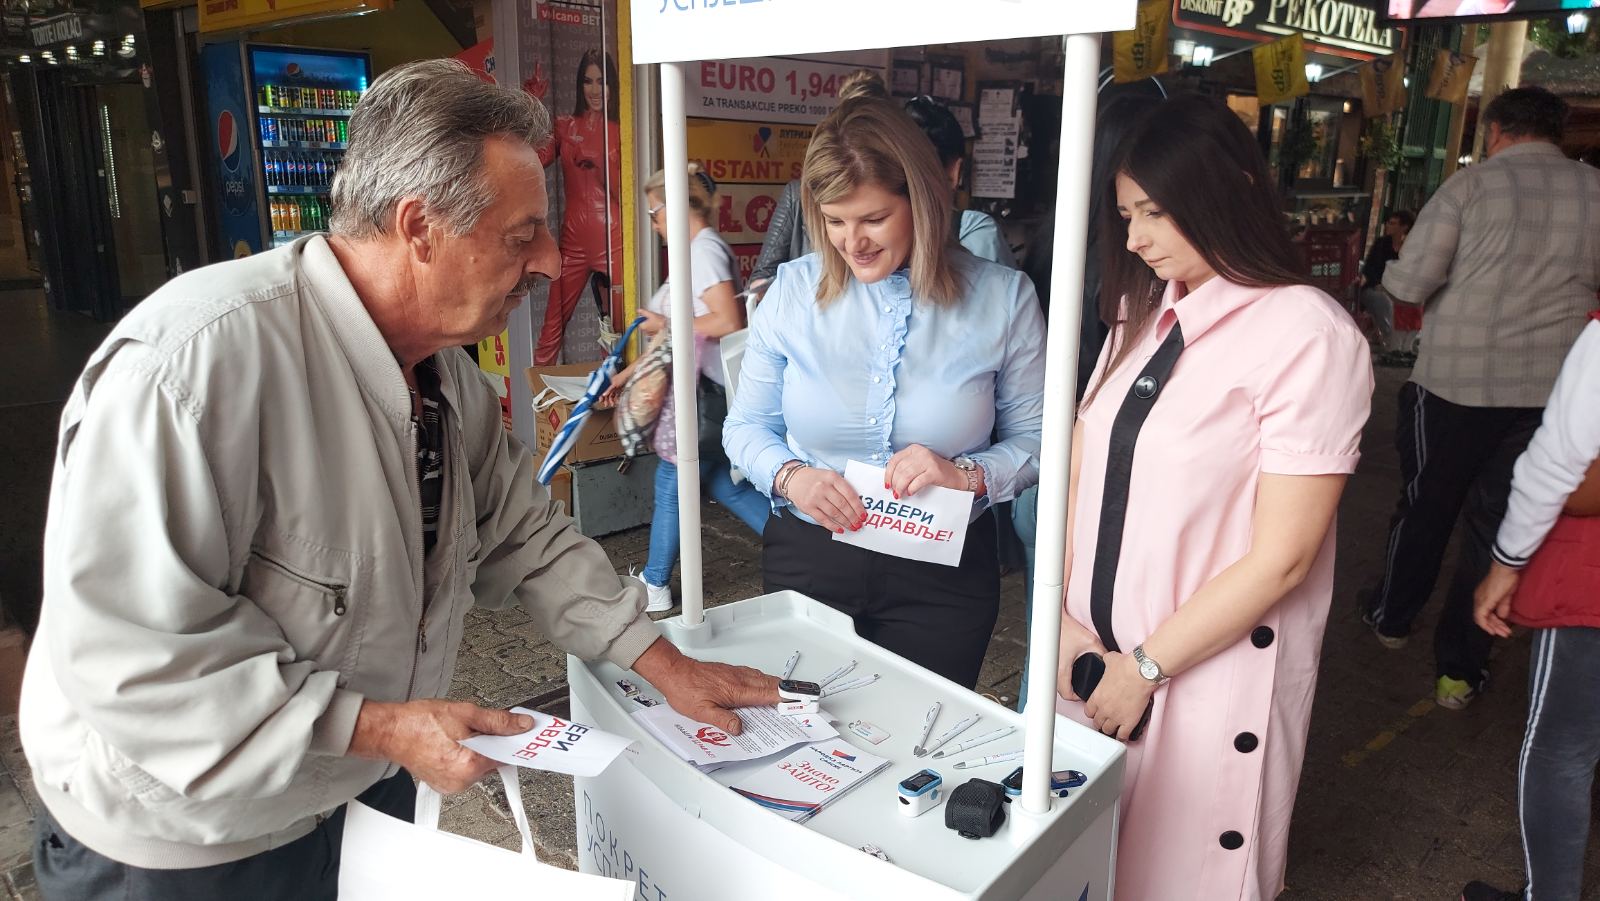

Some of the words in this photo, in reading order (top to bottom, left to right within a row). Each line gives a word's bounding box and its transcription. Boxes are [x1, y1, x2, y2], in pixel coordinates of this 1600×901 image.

[541, 9, 580, 23] vlcano
[582, 16, 600, 26] BET
[1266, 0, 1393, 47] PEKOTEKA
[701, 62, 775, 94] EURO
[703, 97, 714, 107] ZA
[717, 98, 775, 112] TRANSAKCIJE
[778, 106, 806, 114] PREKO
[225, 181, 245, 195] pepsi
[718, 195, 777, 233] LO
[494, 335, 506, 367] SP
[863, 513, 953, 542] ДРАВЉЕ!
[512, 717, 567, 760] АВЉЕ!
[551, 722, 593, 752] ЕРИ
[777, 761, 836, 793] ЗАШТО!
[796, 760, 840, 784] Знамо
[583, 789, 667, 901] ПОКРЕТ
[585, 824, 618, 880] УСП
